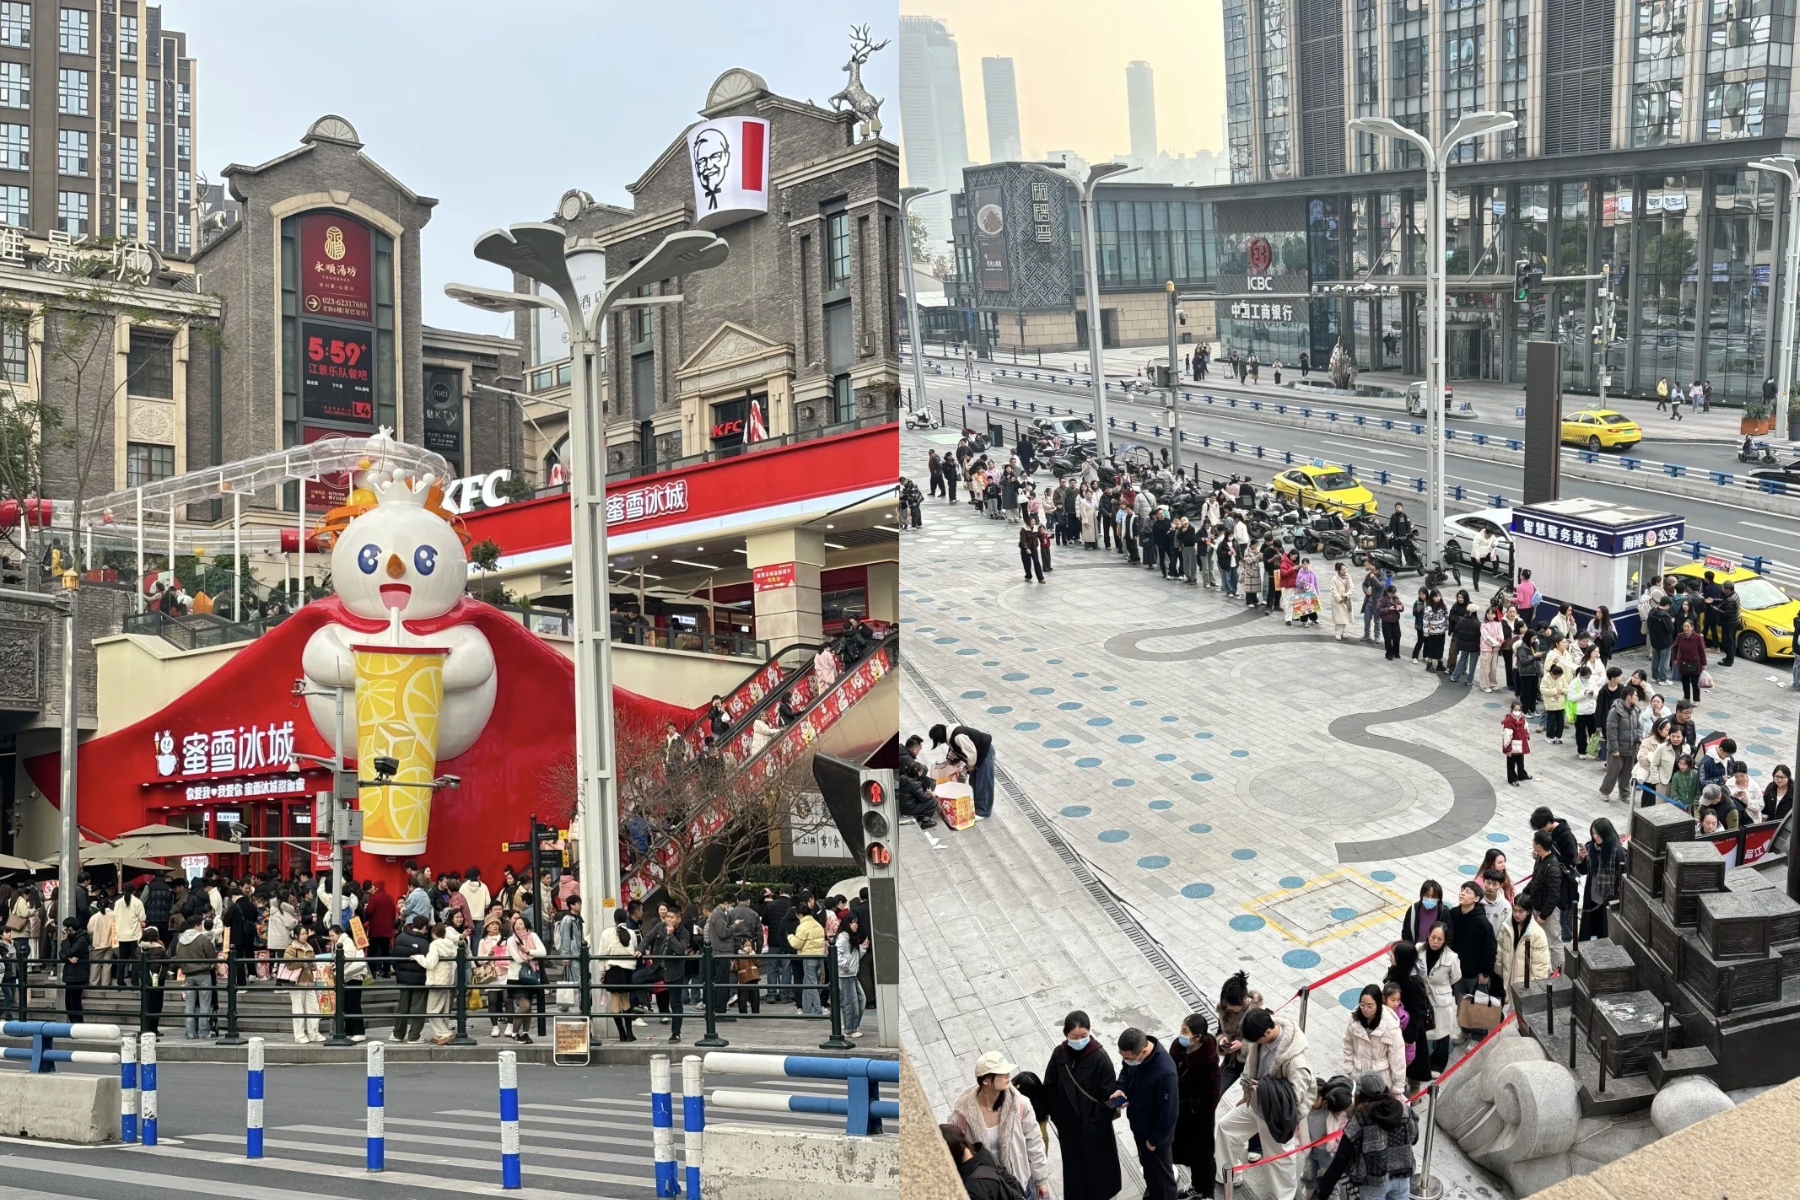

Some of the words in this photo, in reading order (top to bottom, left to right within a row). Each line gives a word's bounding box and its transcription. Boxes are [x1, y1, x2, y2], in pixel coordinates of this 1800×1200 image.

[1247, 276, 1273, 291] ICBC
[1231, 302, 1293, 321] 中国工商银行
[309, 363, 368, 382] 江景乐队餐吧
[433, 389, 448, 398] mei
[353, 403, 370, 417] L4
[712, 419, 743, 437] KFC
[441, 468, 512, 515] KFC
[606, 483, 685, 523] 蜜雪冰城
[1523, 518, 1599, 549] 智慧警务驿站
[1622, 533, 1645, 550] 南岸
[1657, 527, 1679, 543] 公安
[182, 720, 295, 775] 蜜雪冰城
[186, 787, 211, 801] 你爱我
[217, 783, 243, 798] 我爱你
[872, 846, 890, 864] 16
